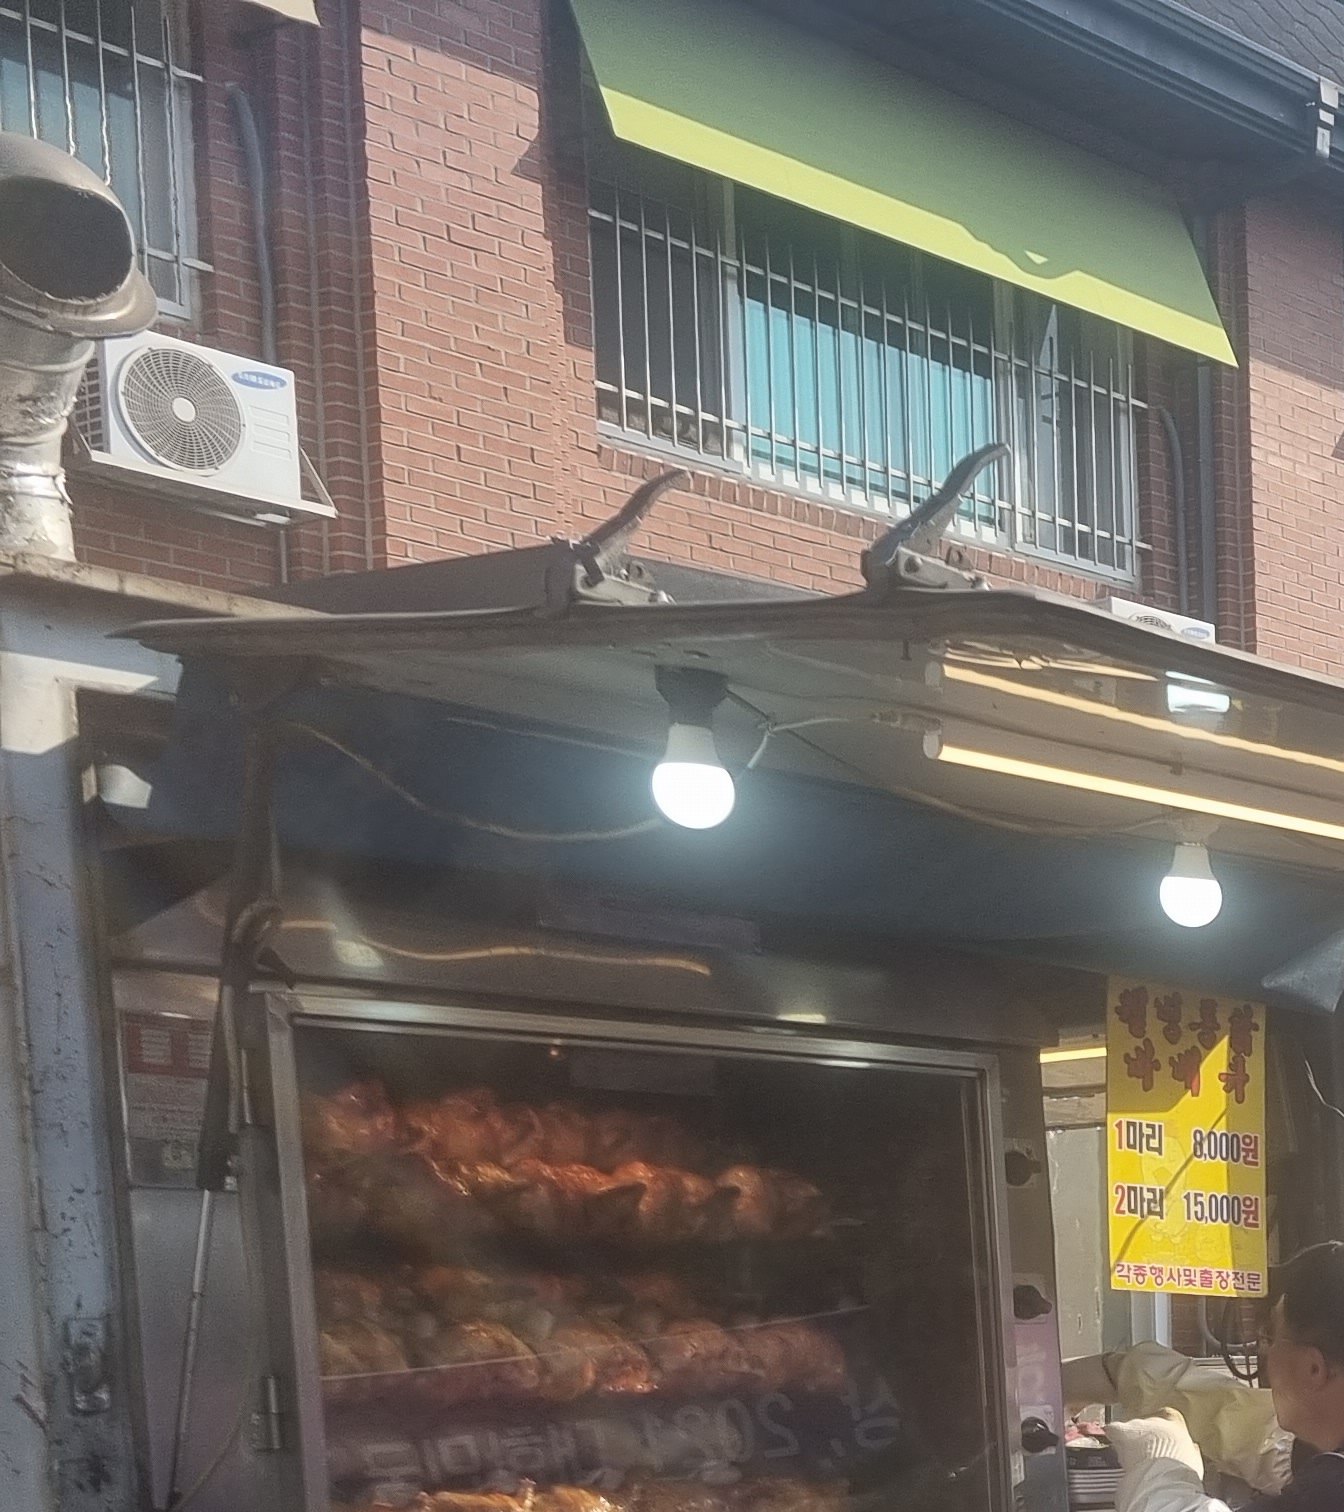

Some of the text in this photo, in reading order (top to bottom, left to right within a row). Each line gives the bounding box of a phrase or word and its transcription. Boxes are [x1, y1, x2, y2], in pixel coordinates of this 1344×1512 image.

[1115, 1120, 1260, 1166] 1마리 8,000원
[1115, 1184, 1260, 1228] 2마리 15,000원
